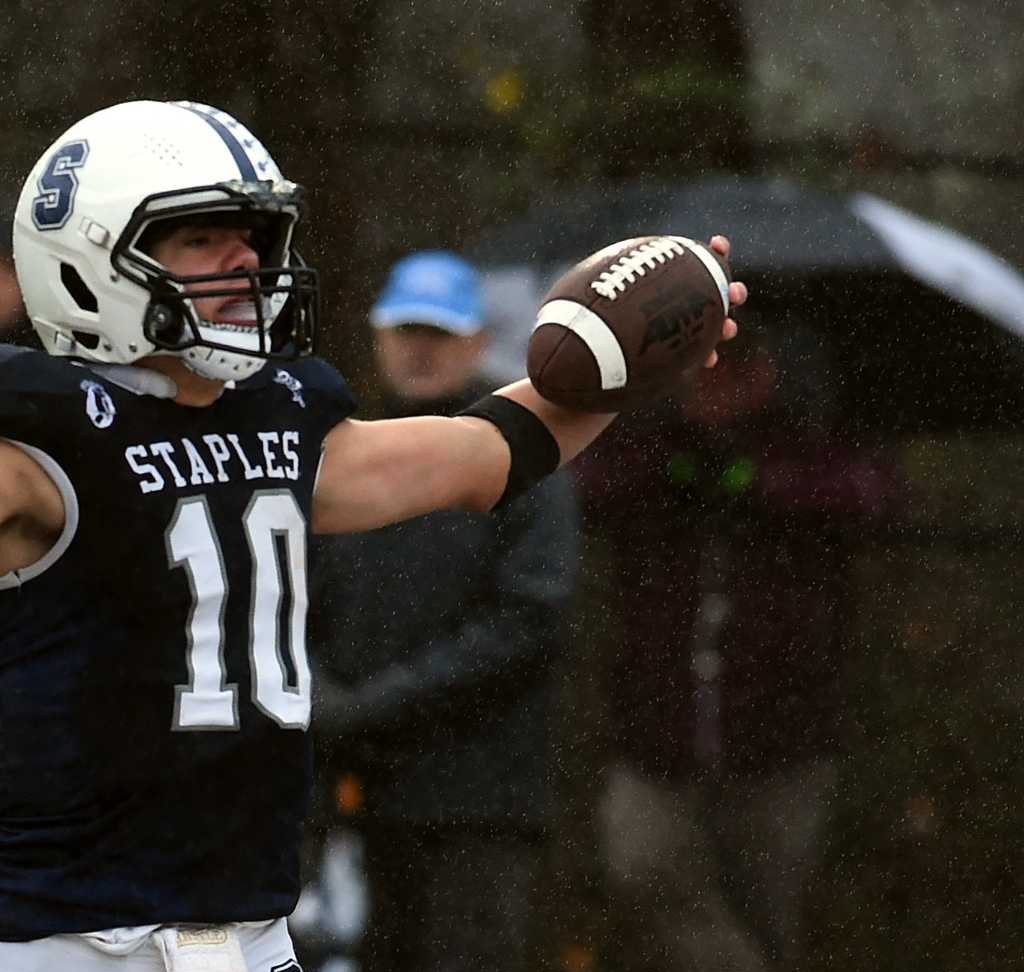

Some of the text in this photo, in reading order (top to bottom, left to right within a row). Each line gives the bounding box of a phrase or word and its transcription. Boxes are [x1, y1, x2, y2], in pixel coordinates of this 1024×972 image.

[31, 138, 90, 231] S
[125, 430, 300, 494] STAPLES
[164, 487, 312, 732] 10
